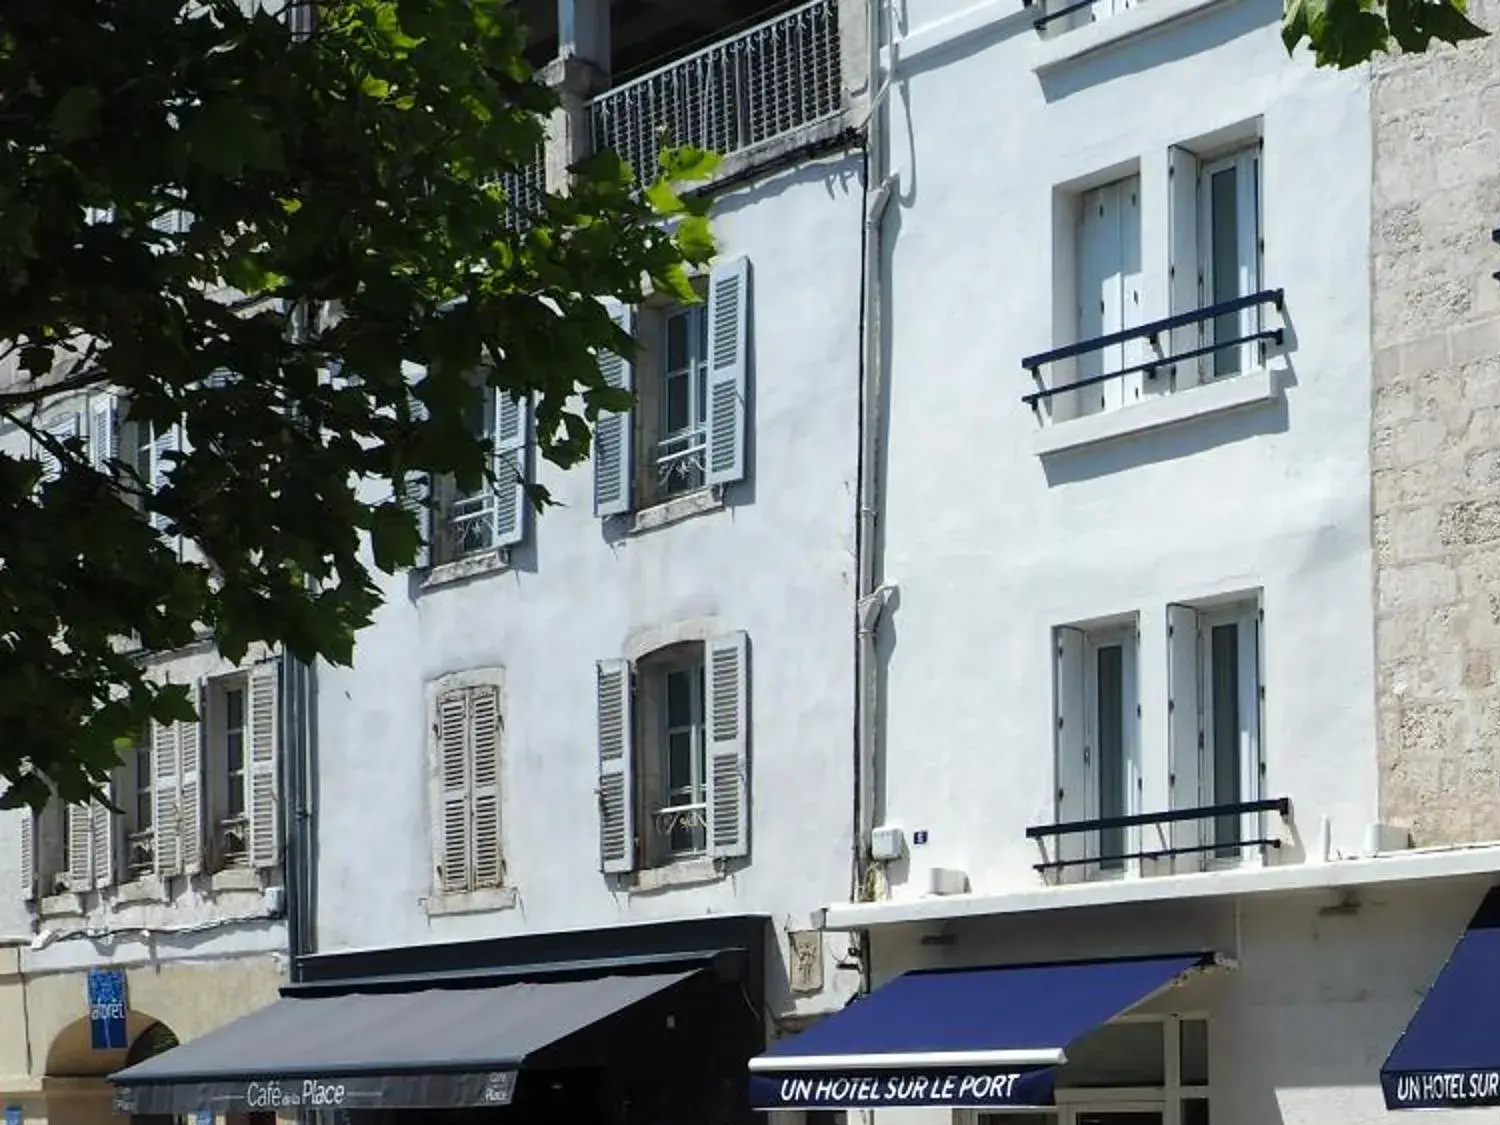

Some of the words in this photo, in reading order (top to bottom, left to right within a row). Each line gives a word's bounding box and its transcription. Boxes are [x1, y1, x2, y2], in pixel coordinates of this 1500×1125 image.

[247, 1080, 282, 1107] Café
[302, 1079, 345, 1105] Place
[780, 1078, 813, 1101] UN
[815, 1076, 881, 1101] HOTEL
[884, 1075, 929, 1099] SUR
[930, 1075, 958, 1099] LE
[959, 1073, 1021, 1098] PORT
[1397, 1075, 1421, 1101] UN
[1423, 1073, 1467, 1100] HOTEL
[1469, 1072, 1499, 1098] SUR
